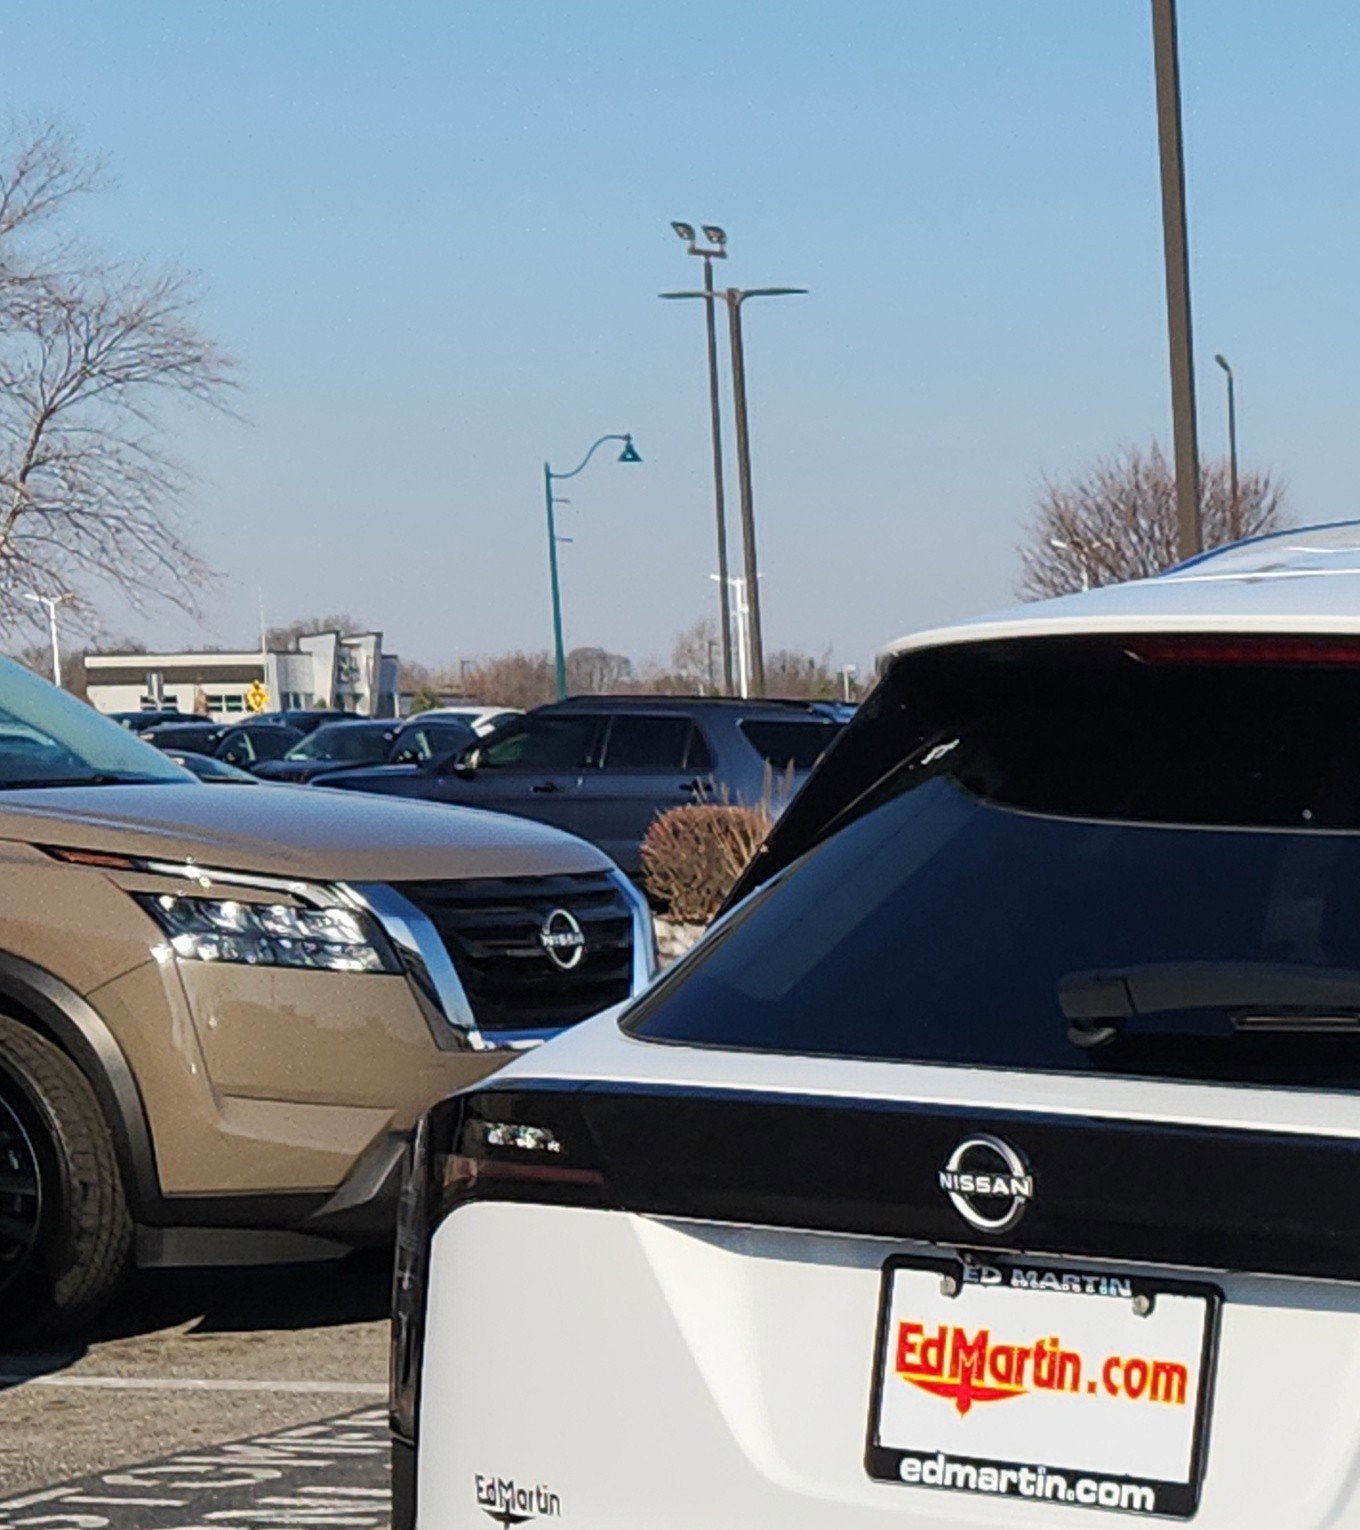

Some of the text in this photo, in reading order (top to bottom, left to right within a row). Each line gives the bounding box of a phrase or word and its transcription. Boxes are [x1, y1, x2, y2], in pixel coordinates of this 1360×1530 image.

[939, 1170, 1034, 1199] NISSAN
[963, 1265, 1133, 1298] ED MARTIN
[895, 1319, 1188, 1406] EdMartin.com
[899, 1453, 1156, 1512] edmartin.com
